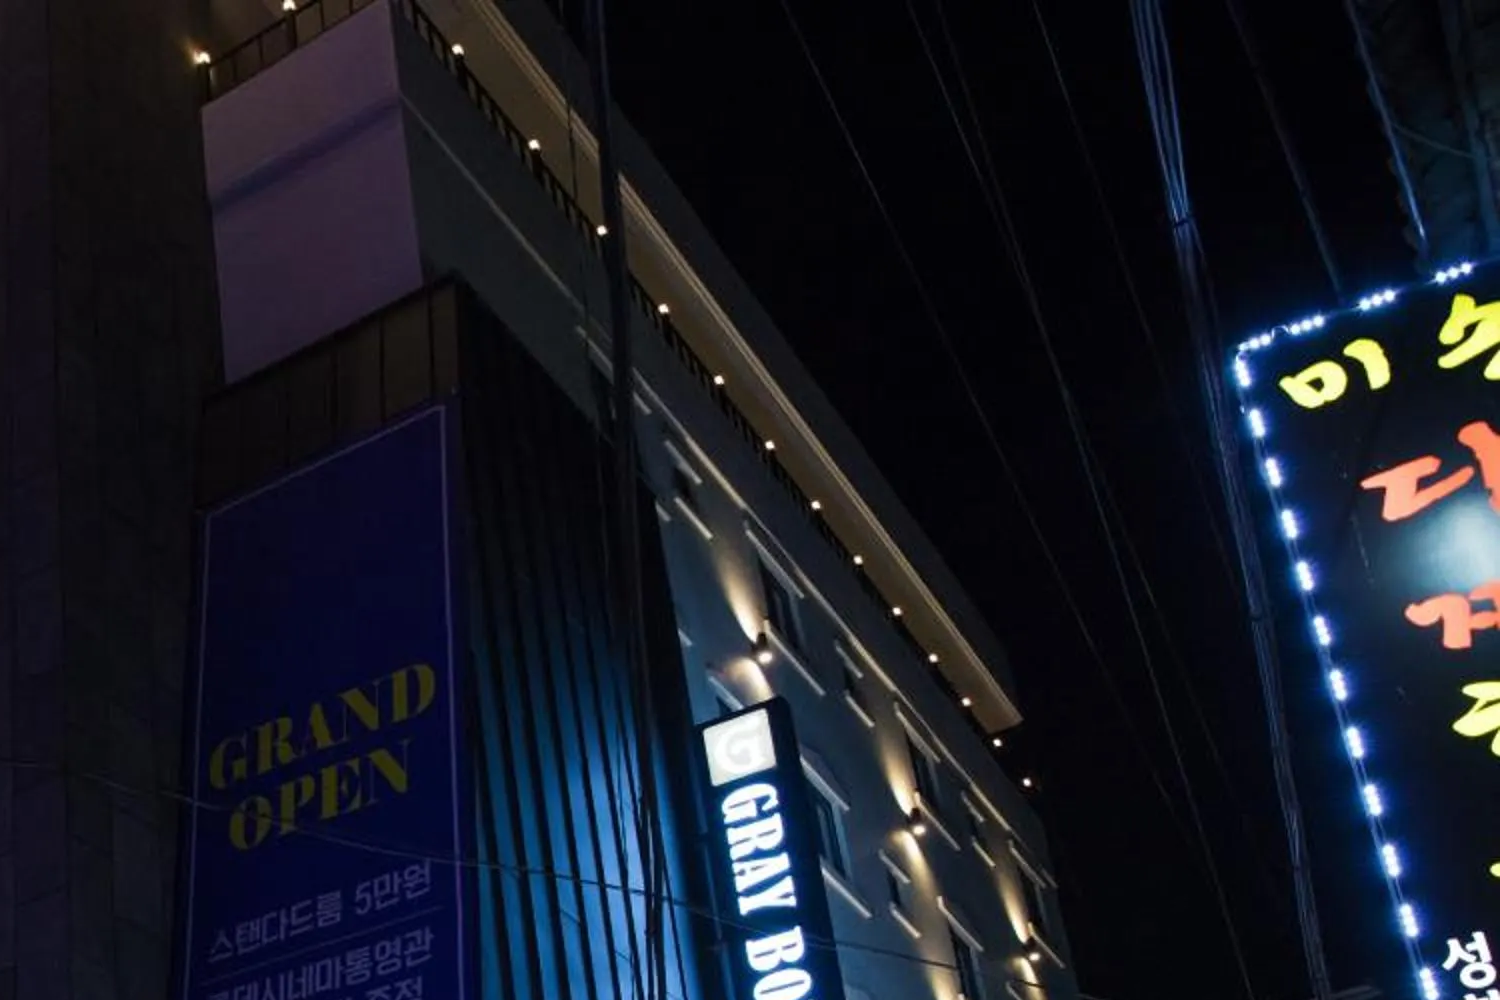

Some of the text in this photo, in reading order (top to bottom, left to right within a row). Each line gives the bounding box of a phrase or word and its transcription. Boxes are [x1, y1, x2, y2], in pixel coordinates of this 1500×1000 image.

[209, 663, 436, 790] GRAND
[229, 737, 413, 851] OPEN
[721, 783, 798, 916] GRAY
[354, 858, 433, 916] 5만원
